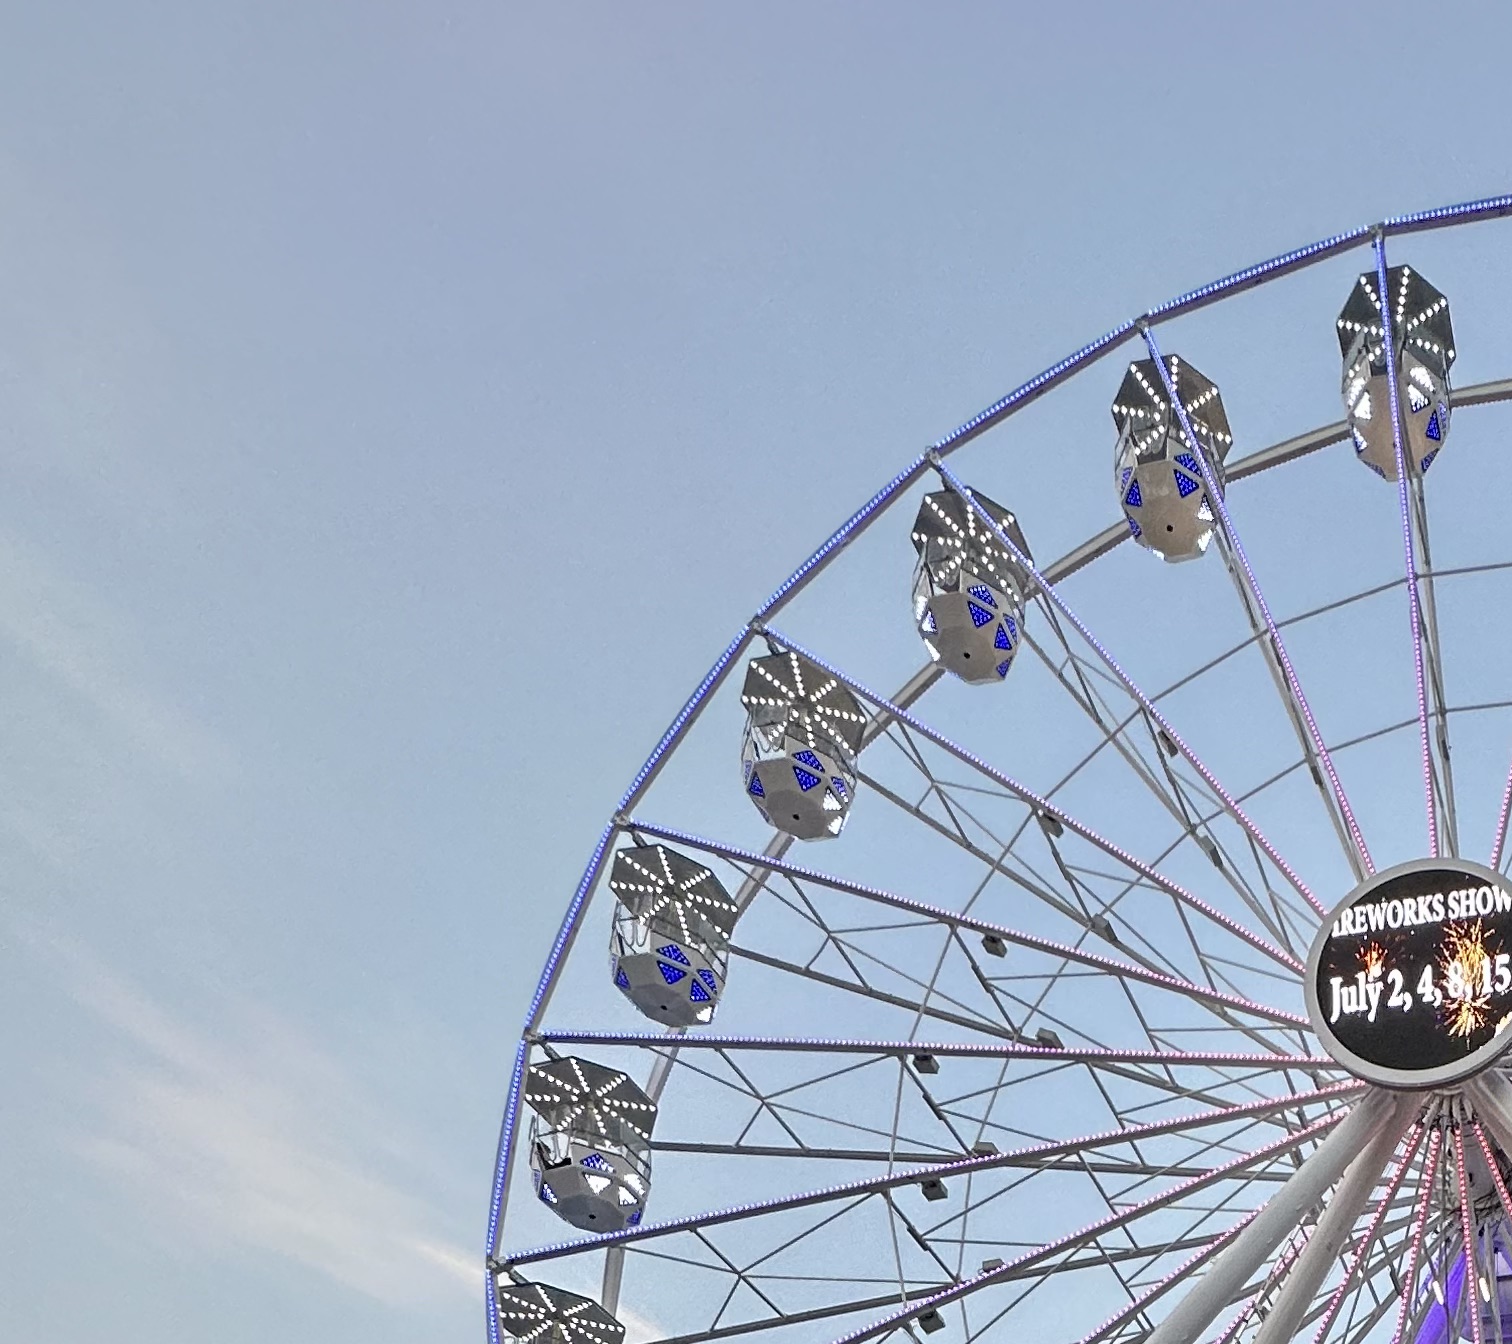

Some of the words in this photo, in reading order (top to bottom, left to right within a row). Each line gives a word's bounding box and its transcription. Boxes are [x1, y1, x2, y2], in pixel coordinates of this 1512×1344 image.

[1331, 894, 1445, 938] IREWORKS
[1329, 971, 1383, 1024] July
[1387, 968, 1412, 1012] 2,
[1417, 964, 1443, 1007] 4,
[1482, 953, 1512, 994] 15
